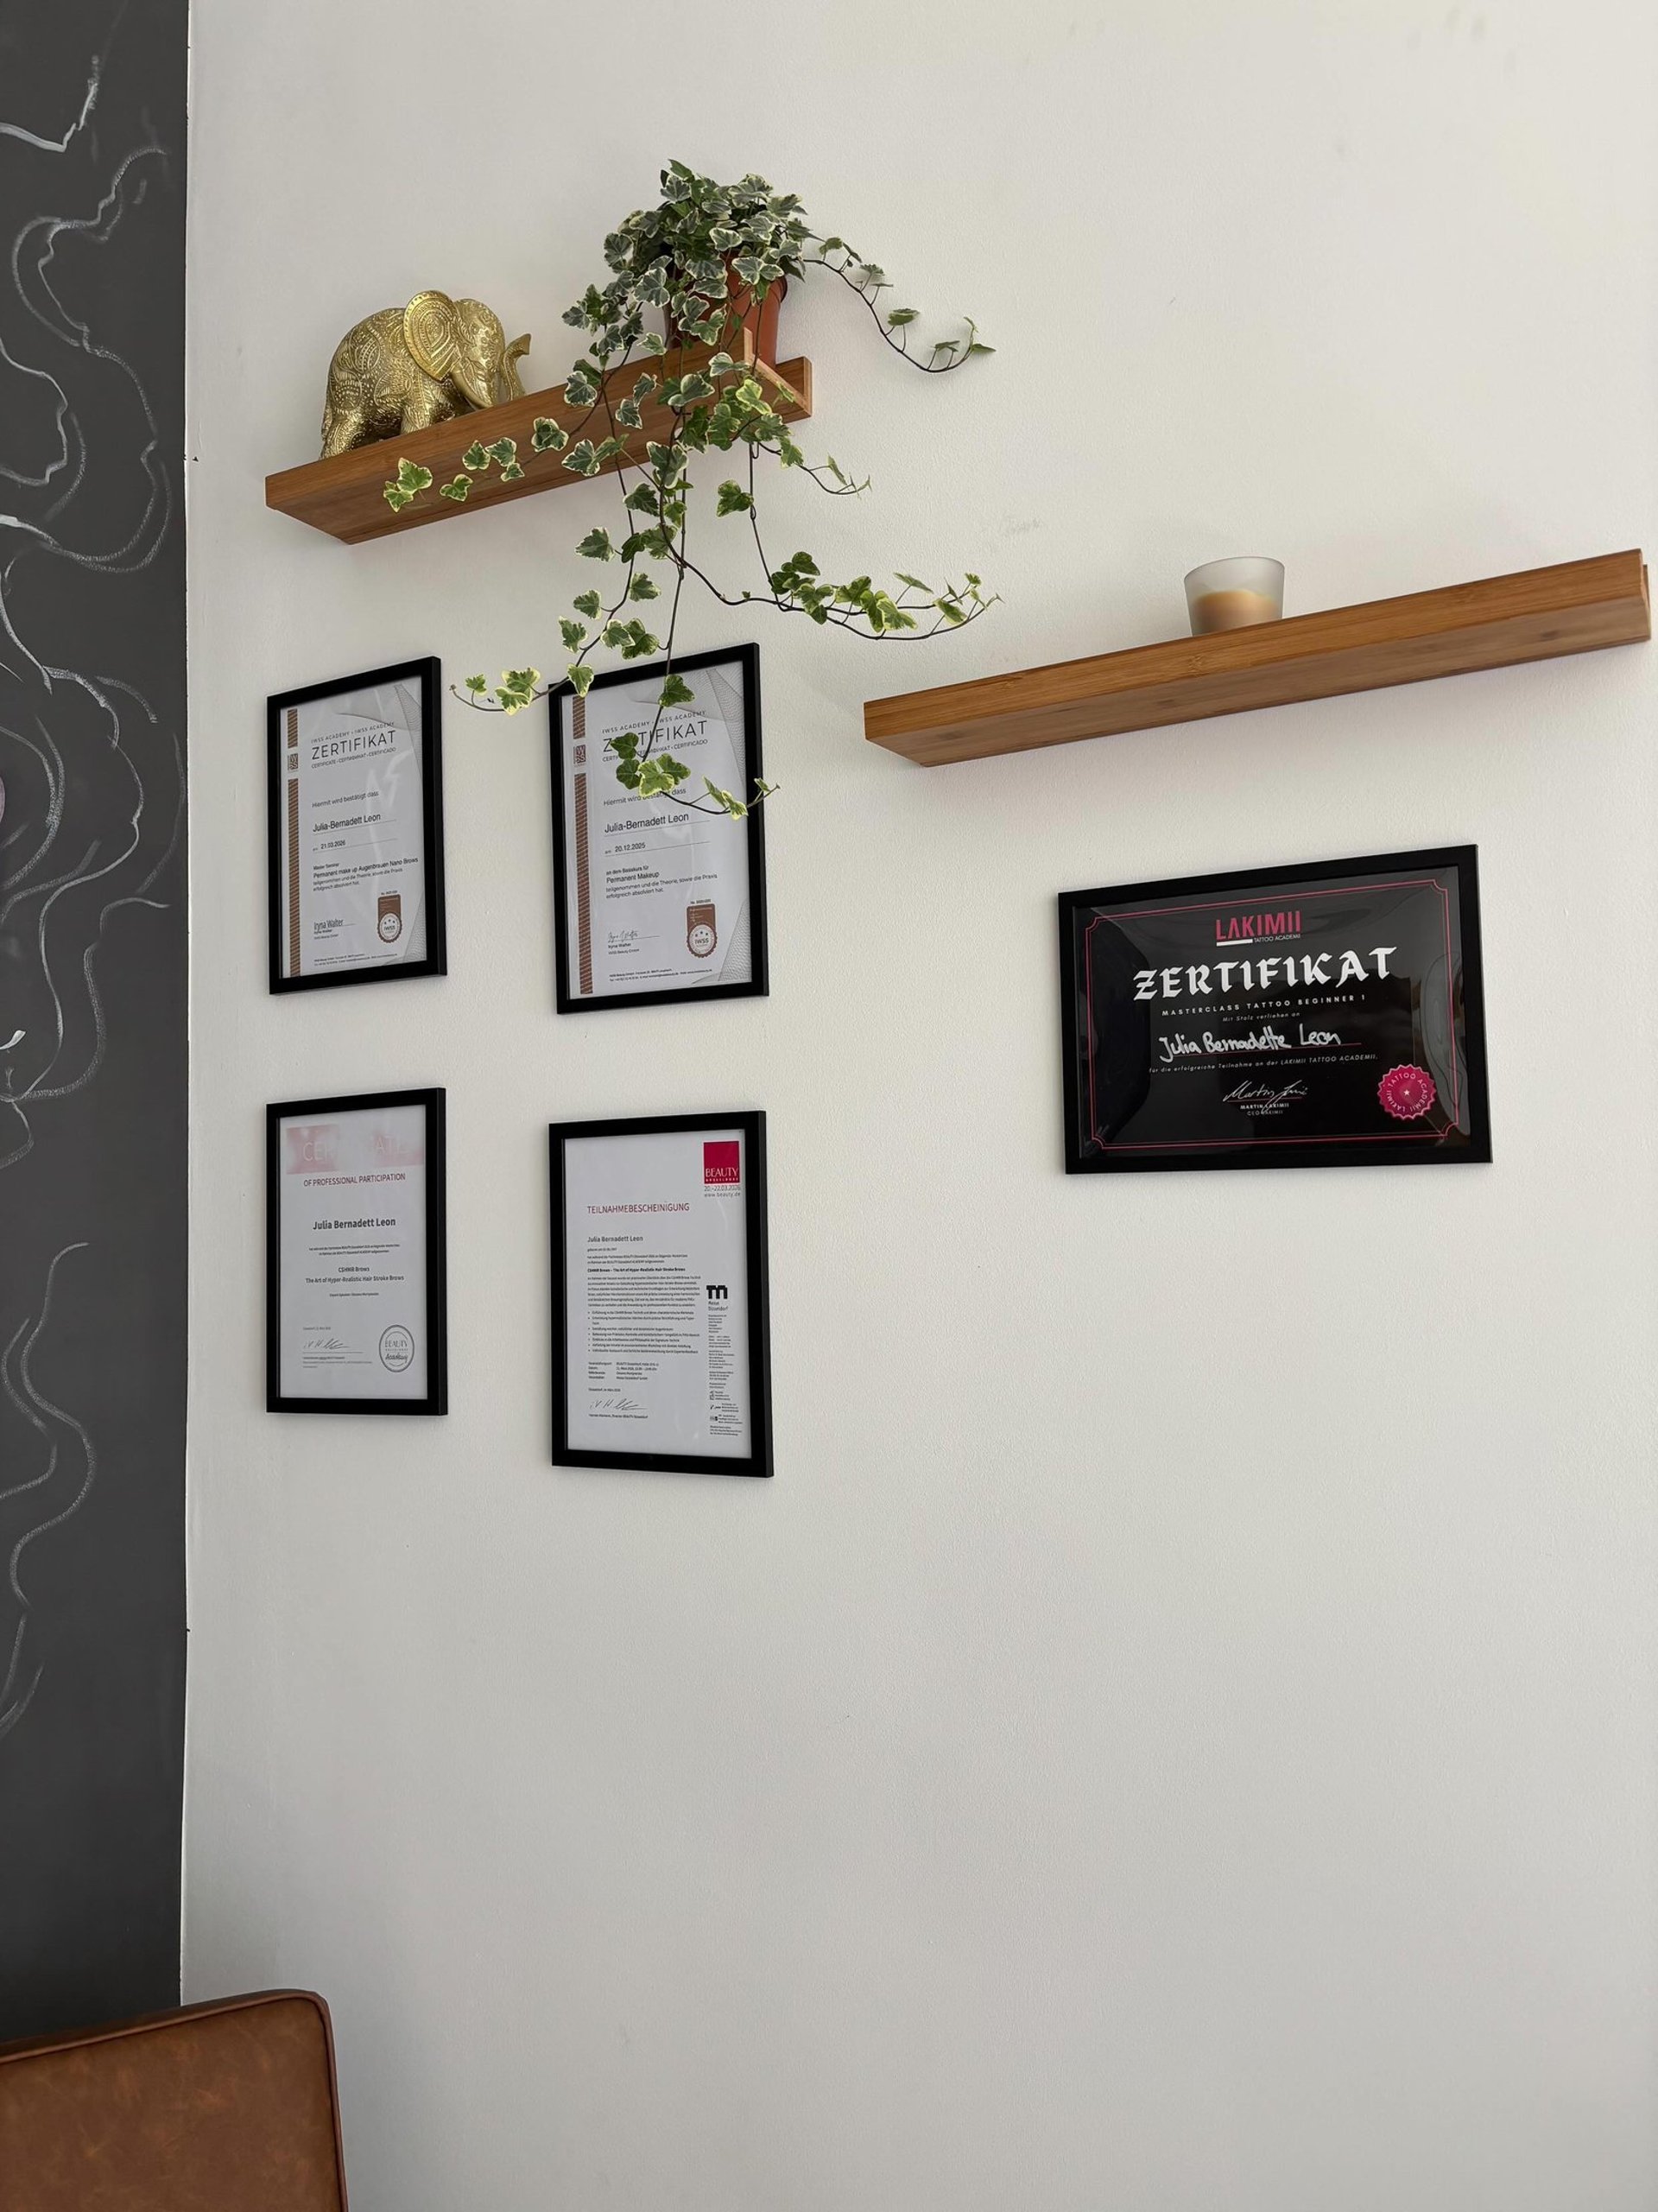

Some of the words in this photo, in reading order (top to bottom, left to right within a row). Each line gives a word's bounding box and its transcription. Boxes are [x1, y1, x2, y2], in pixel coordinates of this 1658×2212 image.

[619, 722, 649, 731] ACADEMY
[674, 710, 706, 720] ACADEMY
[312, 730, 396, 760] ZERTIFIKAT
[326, 732, 350, 743] ACADEMY
[604, 720, 707, 752] ZTIFIKAT
[674, 739, 708, 750] CERTIFICADO
[311, 760, 336, 769] CERTIFICATE
[313, 817, 363, 833] Julia-Bernadett
[364, 814, 381, 824] Leon
[604, 816, 666, 833] Julia-Bernadett
[668, 814, 689, 824] Leon
[313, 869, 338, 878] Permanent
[1216, 910, 1301, 940] LAKIMII
[1133, 947, 1397, 1001] ZERTIFIKAT
[1161, 1004, 1240, 1017] MASTERCLASS
[1246, 1000, 1291, 1010] TATTOO
[1297, 995, 1355, 1005] BEGINNER
[1159, 1032, 1202, 1063] Julia
[1202, 1024, 1292, 1053] Bernadette
[1299, 1023, 1342, 1046] Leon
[1174, 1064, 1215, 1073] erfolgreiche
[1387, 1073, 1416, 1087] TATTOO
[1409, 1078, 1428, 1112] ACADEMII
[313, 1176, 358, 1186] PROFESSIONAL
[359, 1173, 405, 1183] PARTICIPATION
[706, 1167, 738, 1177] BEAUTY
[587, 1203, 689, 1214] TEILNAHMEBESCHEINIGUNG
[313, 1220, 332, 1230] Julia
[334, 1218, 375, 1228] Bernadett
[376, 1218, 396, 1226] Leon
